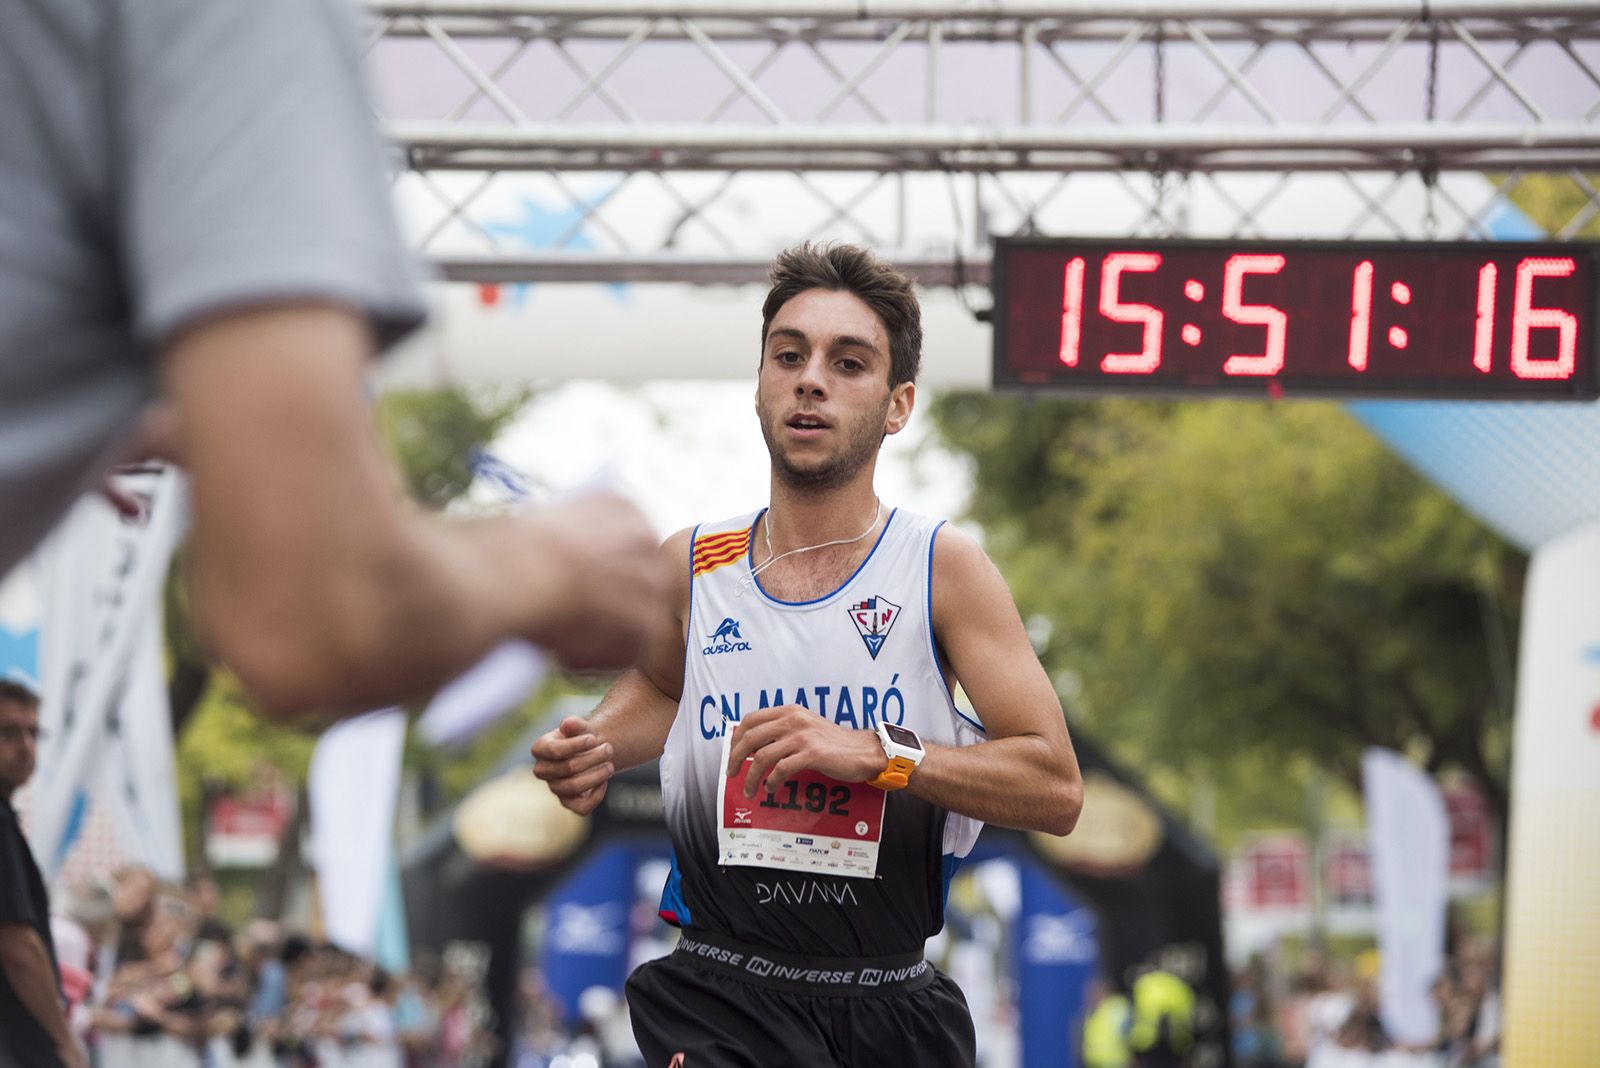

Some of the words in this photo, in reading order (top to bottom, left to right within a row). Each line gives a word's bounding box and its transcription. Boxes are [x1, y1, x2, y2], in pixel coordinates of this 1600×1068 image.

[1059, 252, 1577, 379] 15:51:16
[856, 612, 867, 626] C
[881, 608, 893, 626] N
[703, 641, 752, 656] austral
[760, 779, 851, 816] 1192
[681, 936, 744, 966] INVERSE
[747, 956, 772, 976] IN
[773, 965, 855, 984] INVERSE
